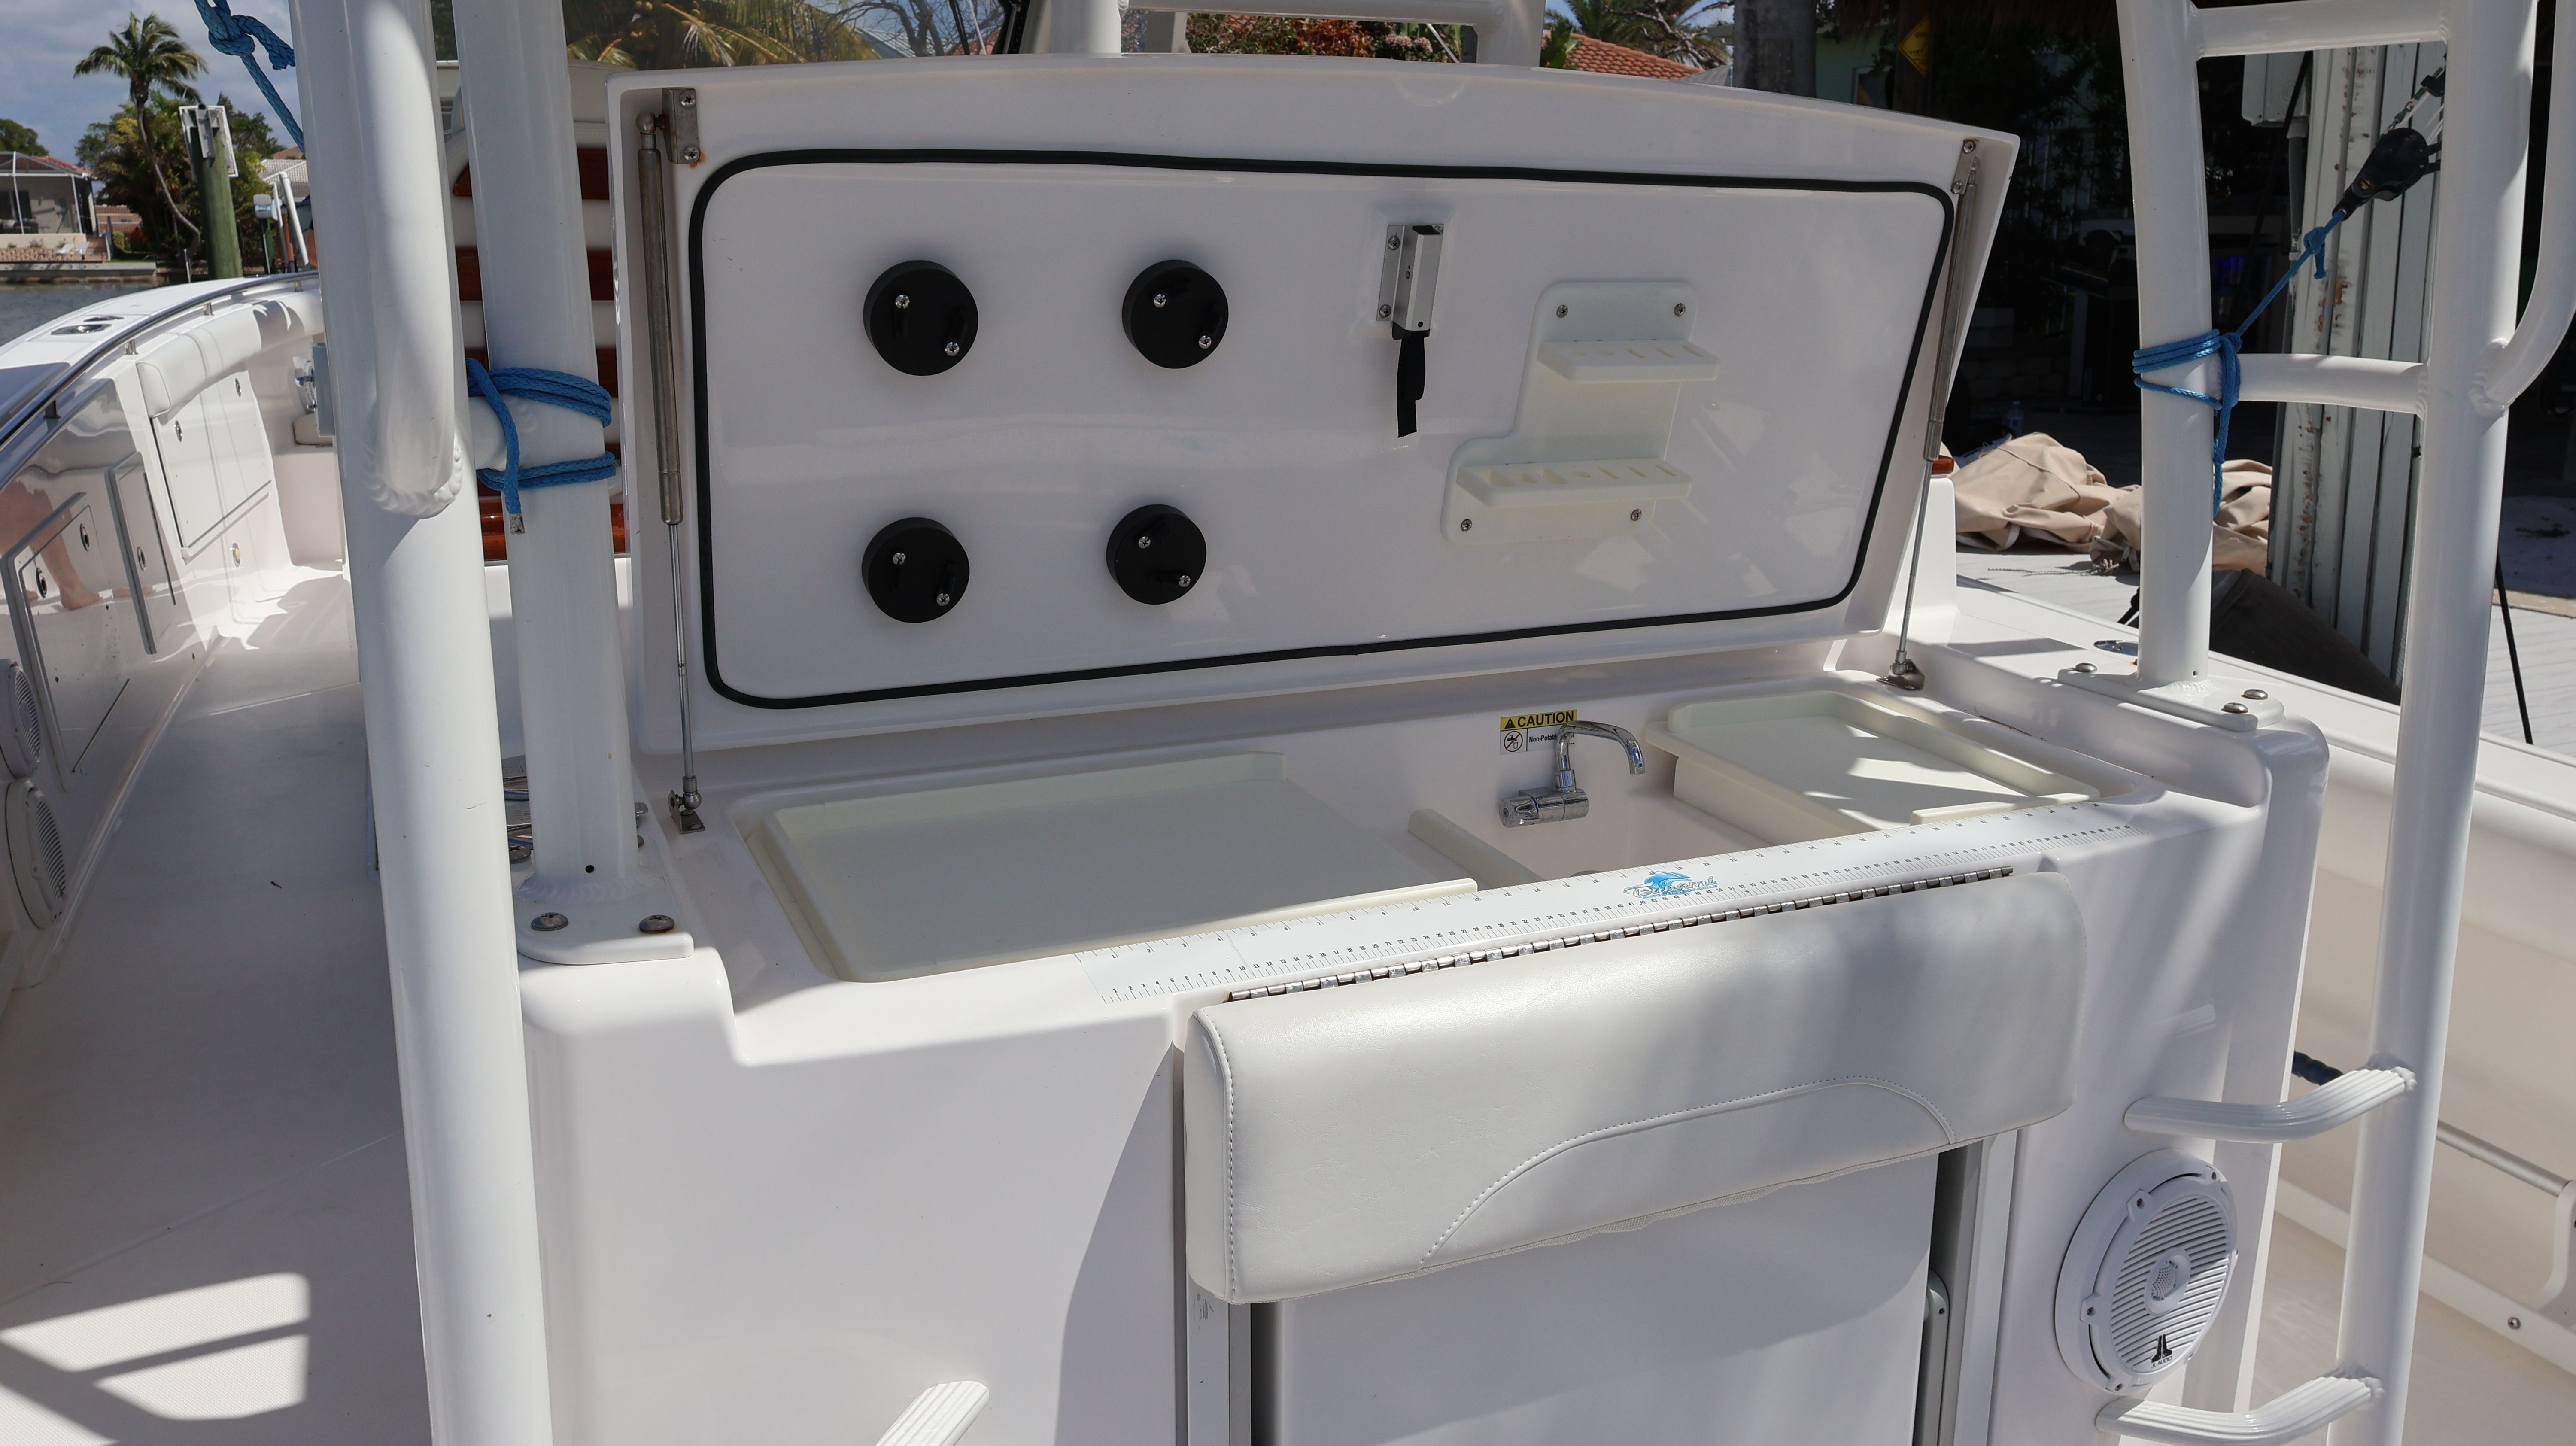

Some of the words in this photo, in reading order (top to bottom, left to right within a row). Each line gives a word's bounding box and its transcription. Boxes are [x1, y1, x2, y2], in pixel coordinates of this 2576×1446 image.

[1518, 711, 1574, 727] CAUTION
[1529, 734, 1557, 742] Non-Potabl
[1623, 876, 1719, 898] Tsunami
